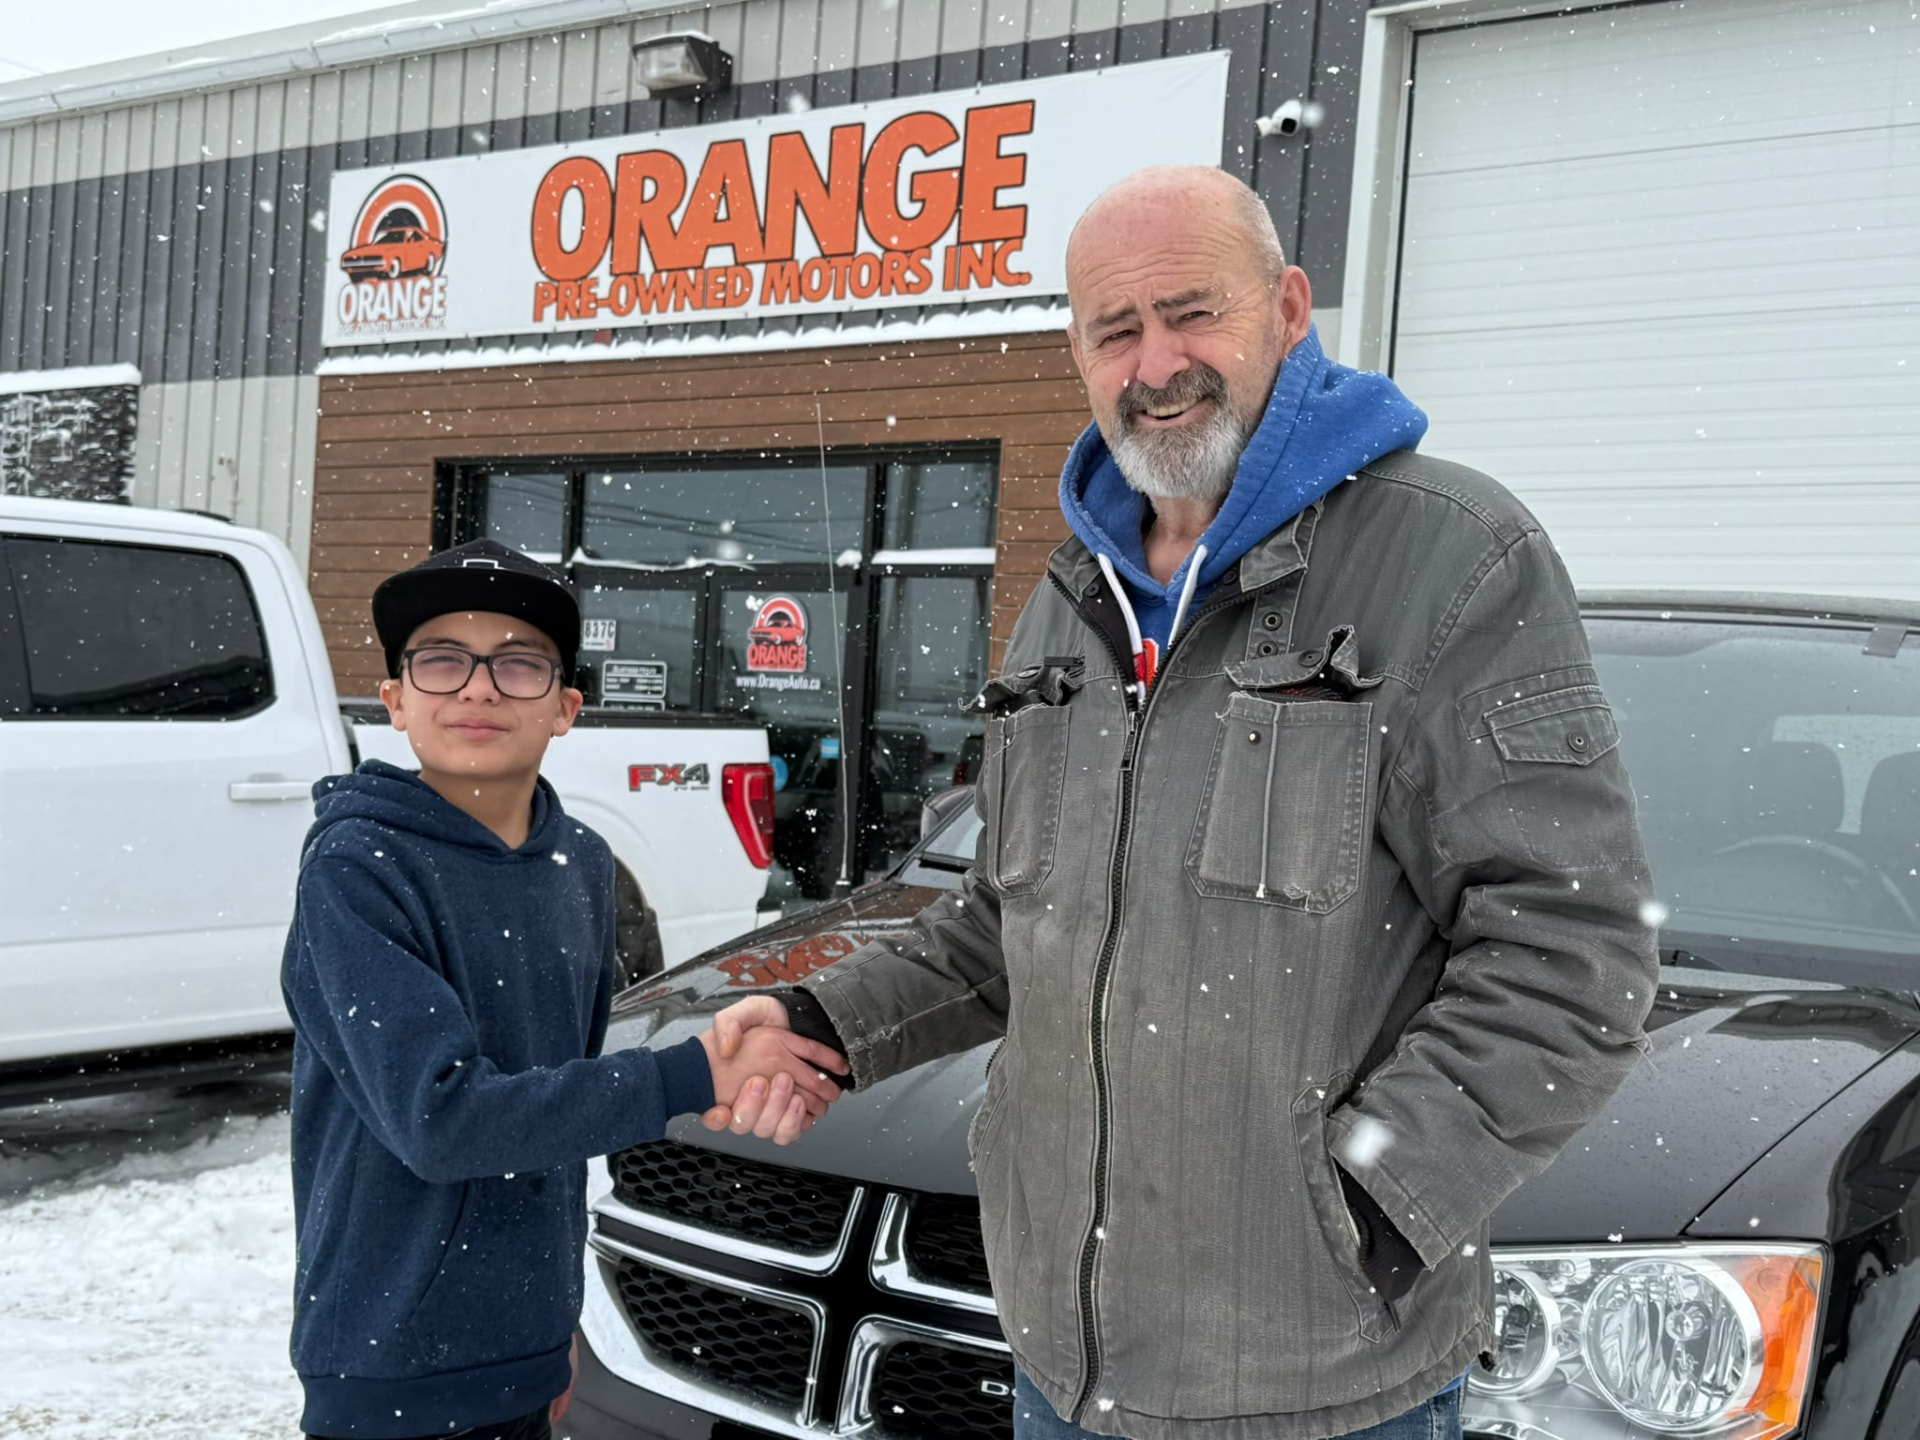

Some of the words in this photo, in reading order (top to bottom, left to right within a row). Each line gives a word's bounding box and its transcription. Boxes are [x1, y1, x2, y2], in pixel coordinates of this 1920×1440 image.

[531, 99, 1035, 283] ORANGE
[533, 265, 754, 322] PRE-OWNED
[759, 247, 933, 306] MOTORS
[942, 238, 1032, 292] INC.
[339, 276, 448, 325] ORANGE
[748, 644, 806, 667] ORANGE
[736, 673, 821, 692] www.OrangeAuto.ca
[628, 762, 710, 792] FX4
